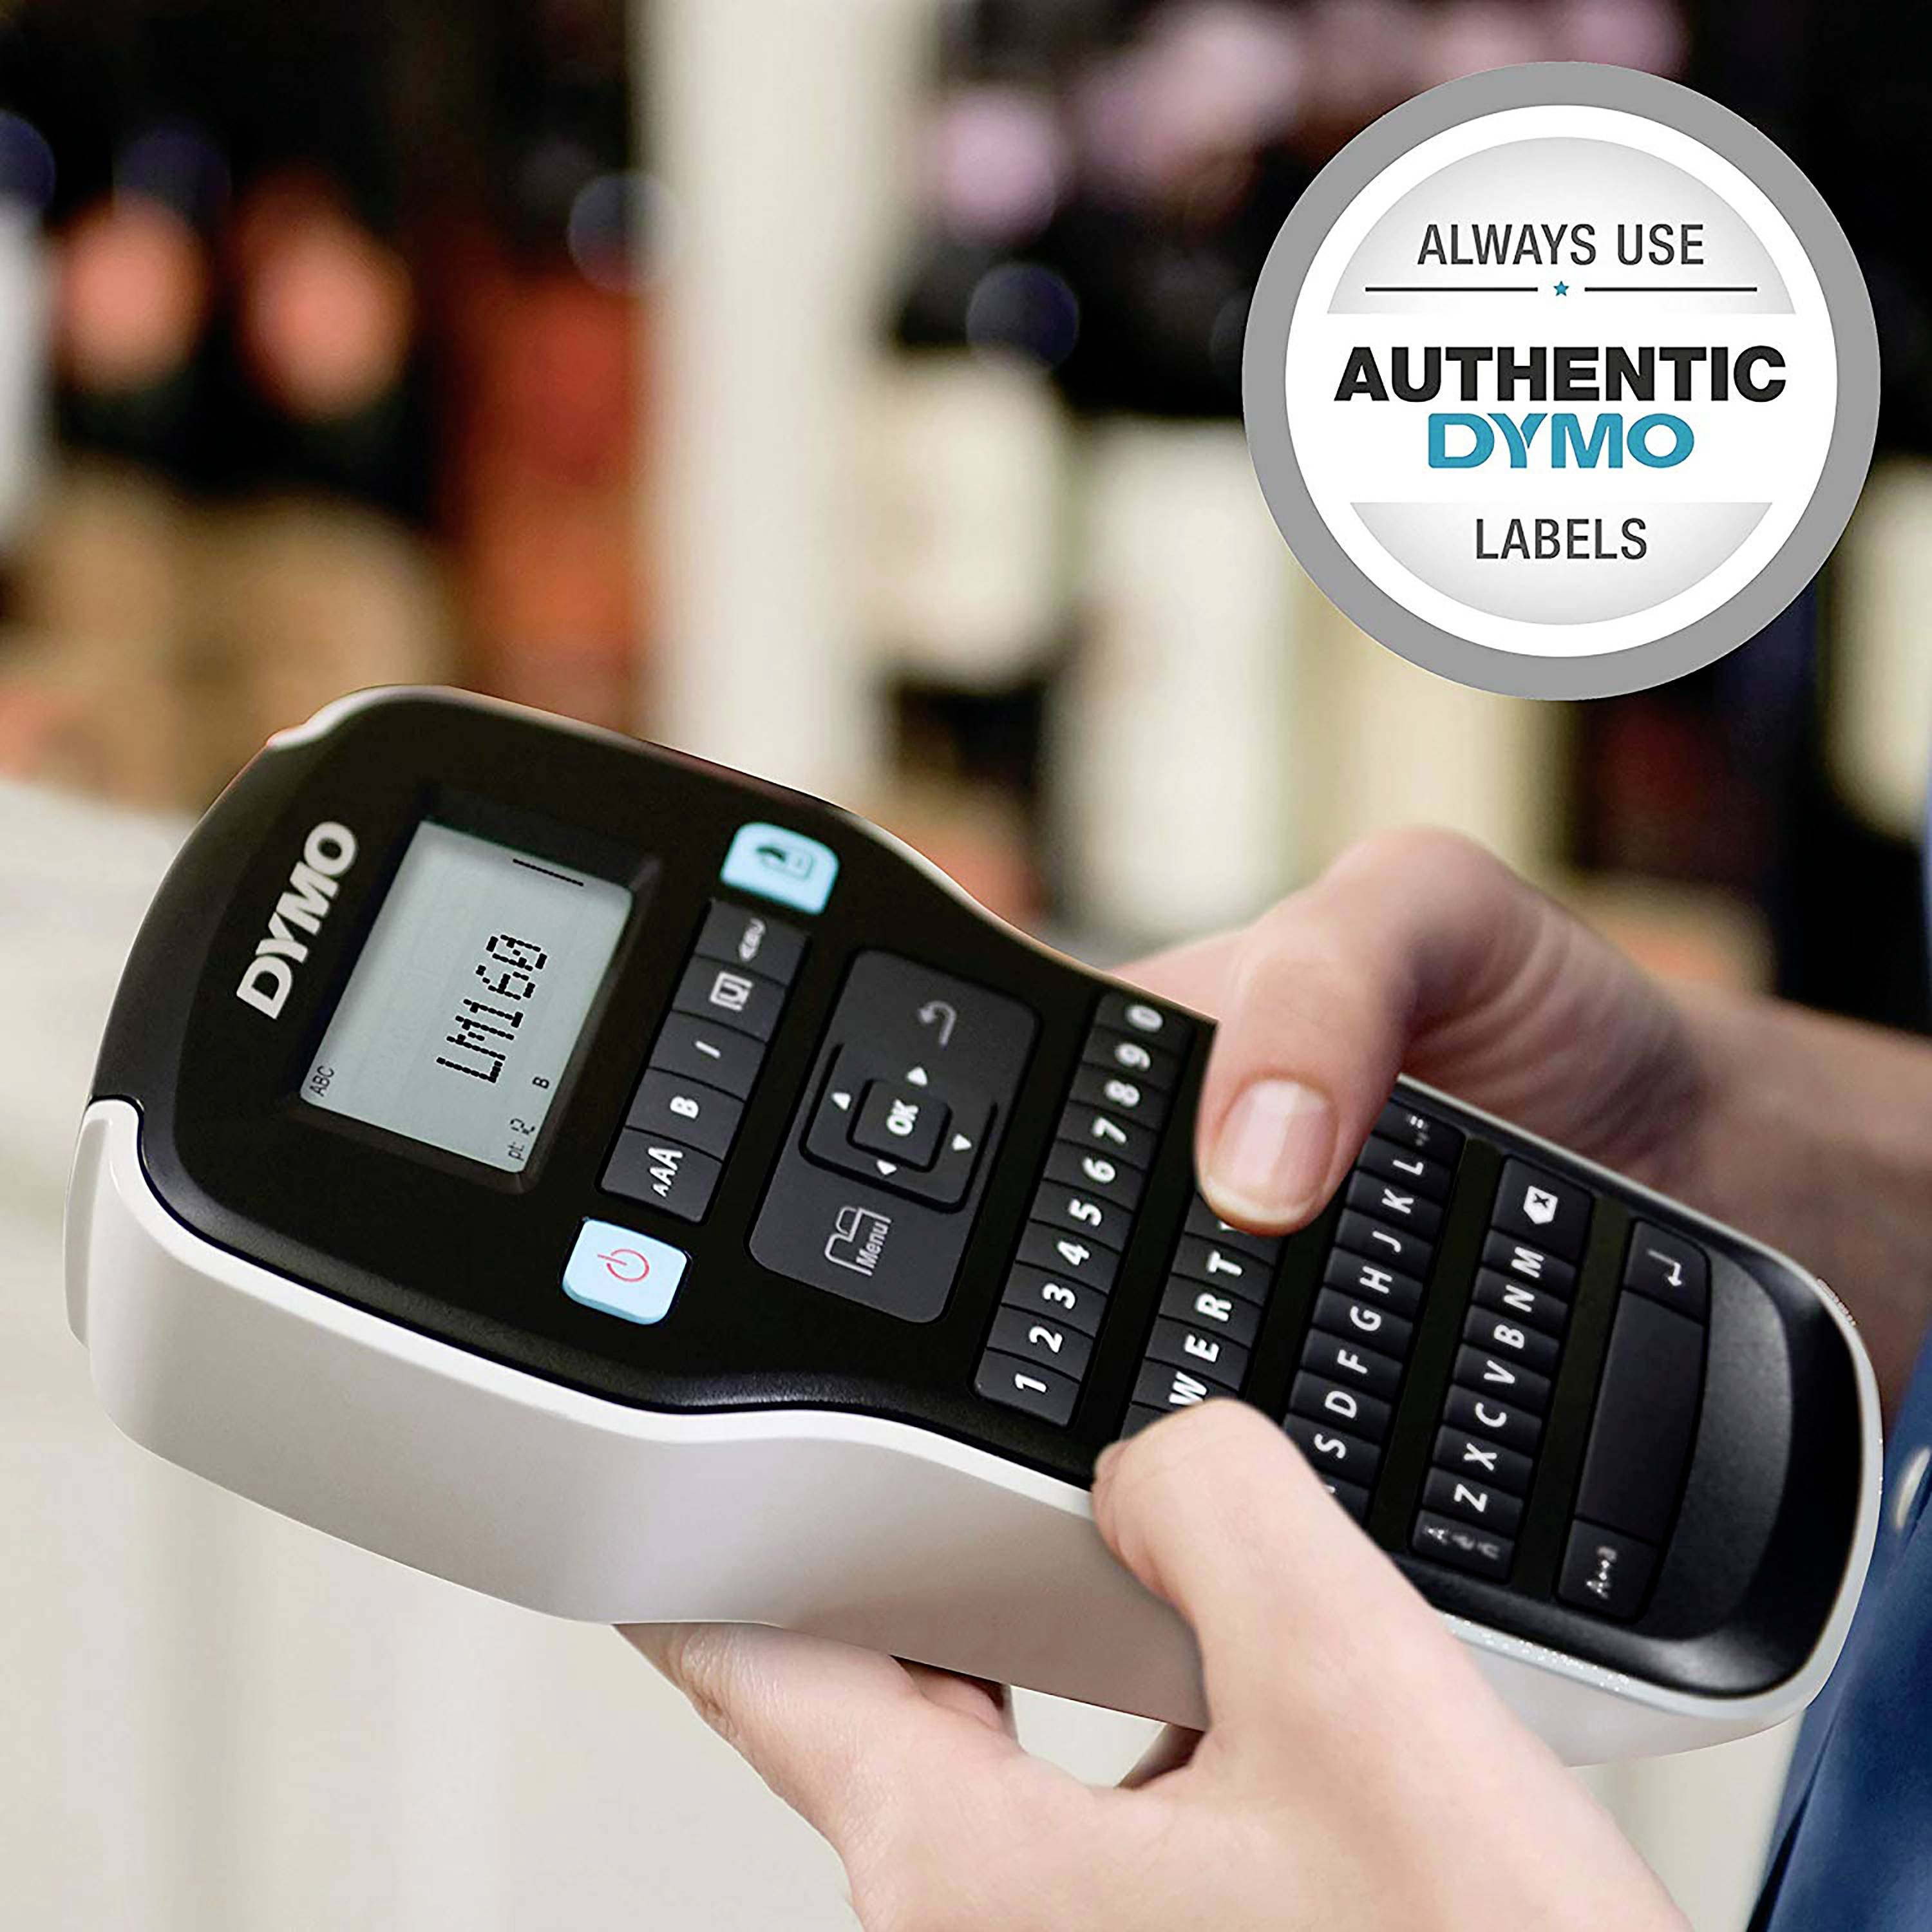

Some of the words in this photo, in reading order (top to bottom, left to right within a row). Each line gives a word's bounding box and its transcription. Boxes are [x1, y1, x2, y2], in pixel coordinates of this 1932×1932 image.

[236, 822, 358, 1019] DYMO
[436, 934, 547, 1083] LM160
[1116, 1043, 1150, 1068] 9
[309, 1065, 334, 1097] ABC
[532, 1076, 550, 1090] B
[1106, 1081, 1140, 1106] 8
[670, 1095, 699, 1119] B
[886, 1099, 919, 1136] OK
[1094, 1118, 1126, 1142] 7
[1083, 1158, 1115, 1182] 6
[1393, 1160, 1423, 1175] L
[1069, 1200, 1101, 1226] 5
[1382, 1189, 1414, 1213] K
[856, 1221, 889, 1269] Menu
[1057, 1241, 1089, 1265] 4
[1373, 1231, 1401, 1252] J
[1208, 1251, 1242, 1275] T
[1511, 1247, 1544, 1278] M
[1360, 1266, 1392, 1293] H
[1043, 1283, 1075, 1309] 3
[1196, 1294, 1231, 1321] R
[1504, 1285, 1534, 1312] N
[1350, 1306, 1381, 1331] G
[1029, 1327, 1062, 1352] 2
[1185, 1335, 1218, 1361] E
[1494, 1325, 1524, 1349] B
[1338, 1350, 1367, 1373] F
[1484, 1360, 1515, 1383] V
[1015, 1374, 1046, 1392] 1
[1169, 1371, 1208, 1405] W
[1325, 1391, 1356, 1417] D
[1475, 1403, 1506, 1427] C
[1314, 1434, 1345, 1458] S
[1464, 1443, 1497, 1470] X
[1454, 1484, 1487, 1511] Z
